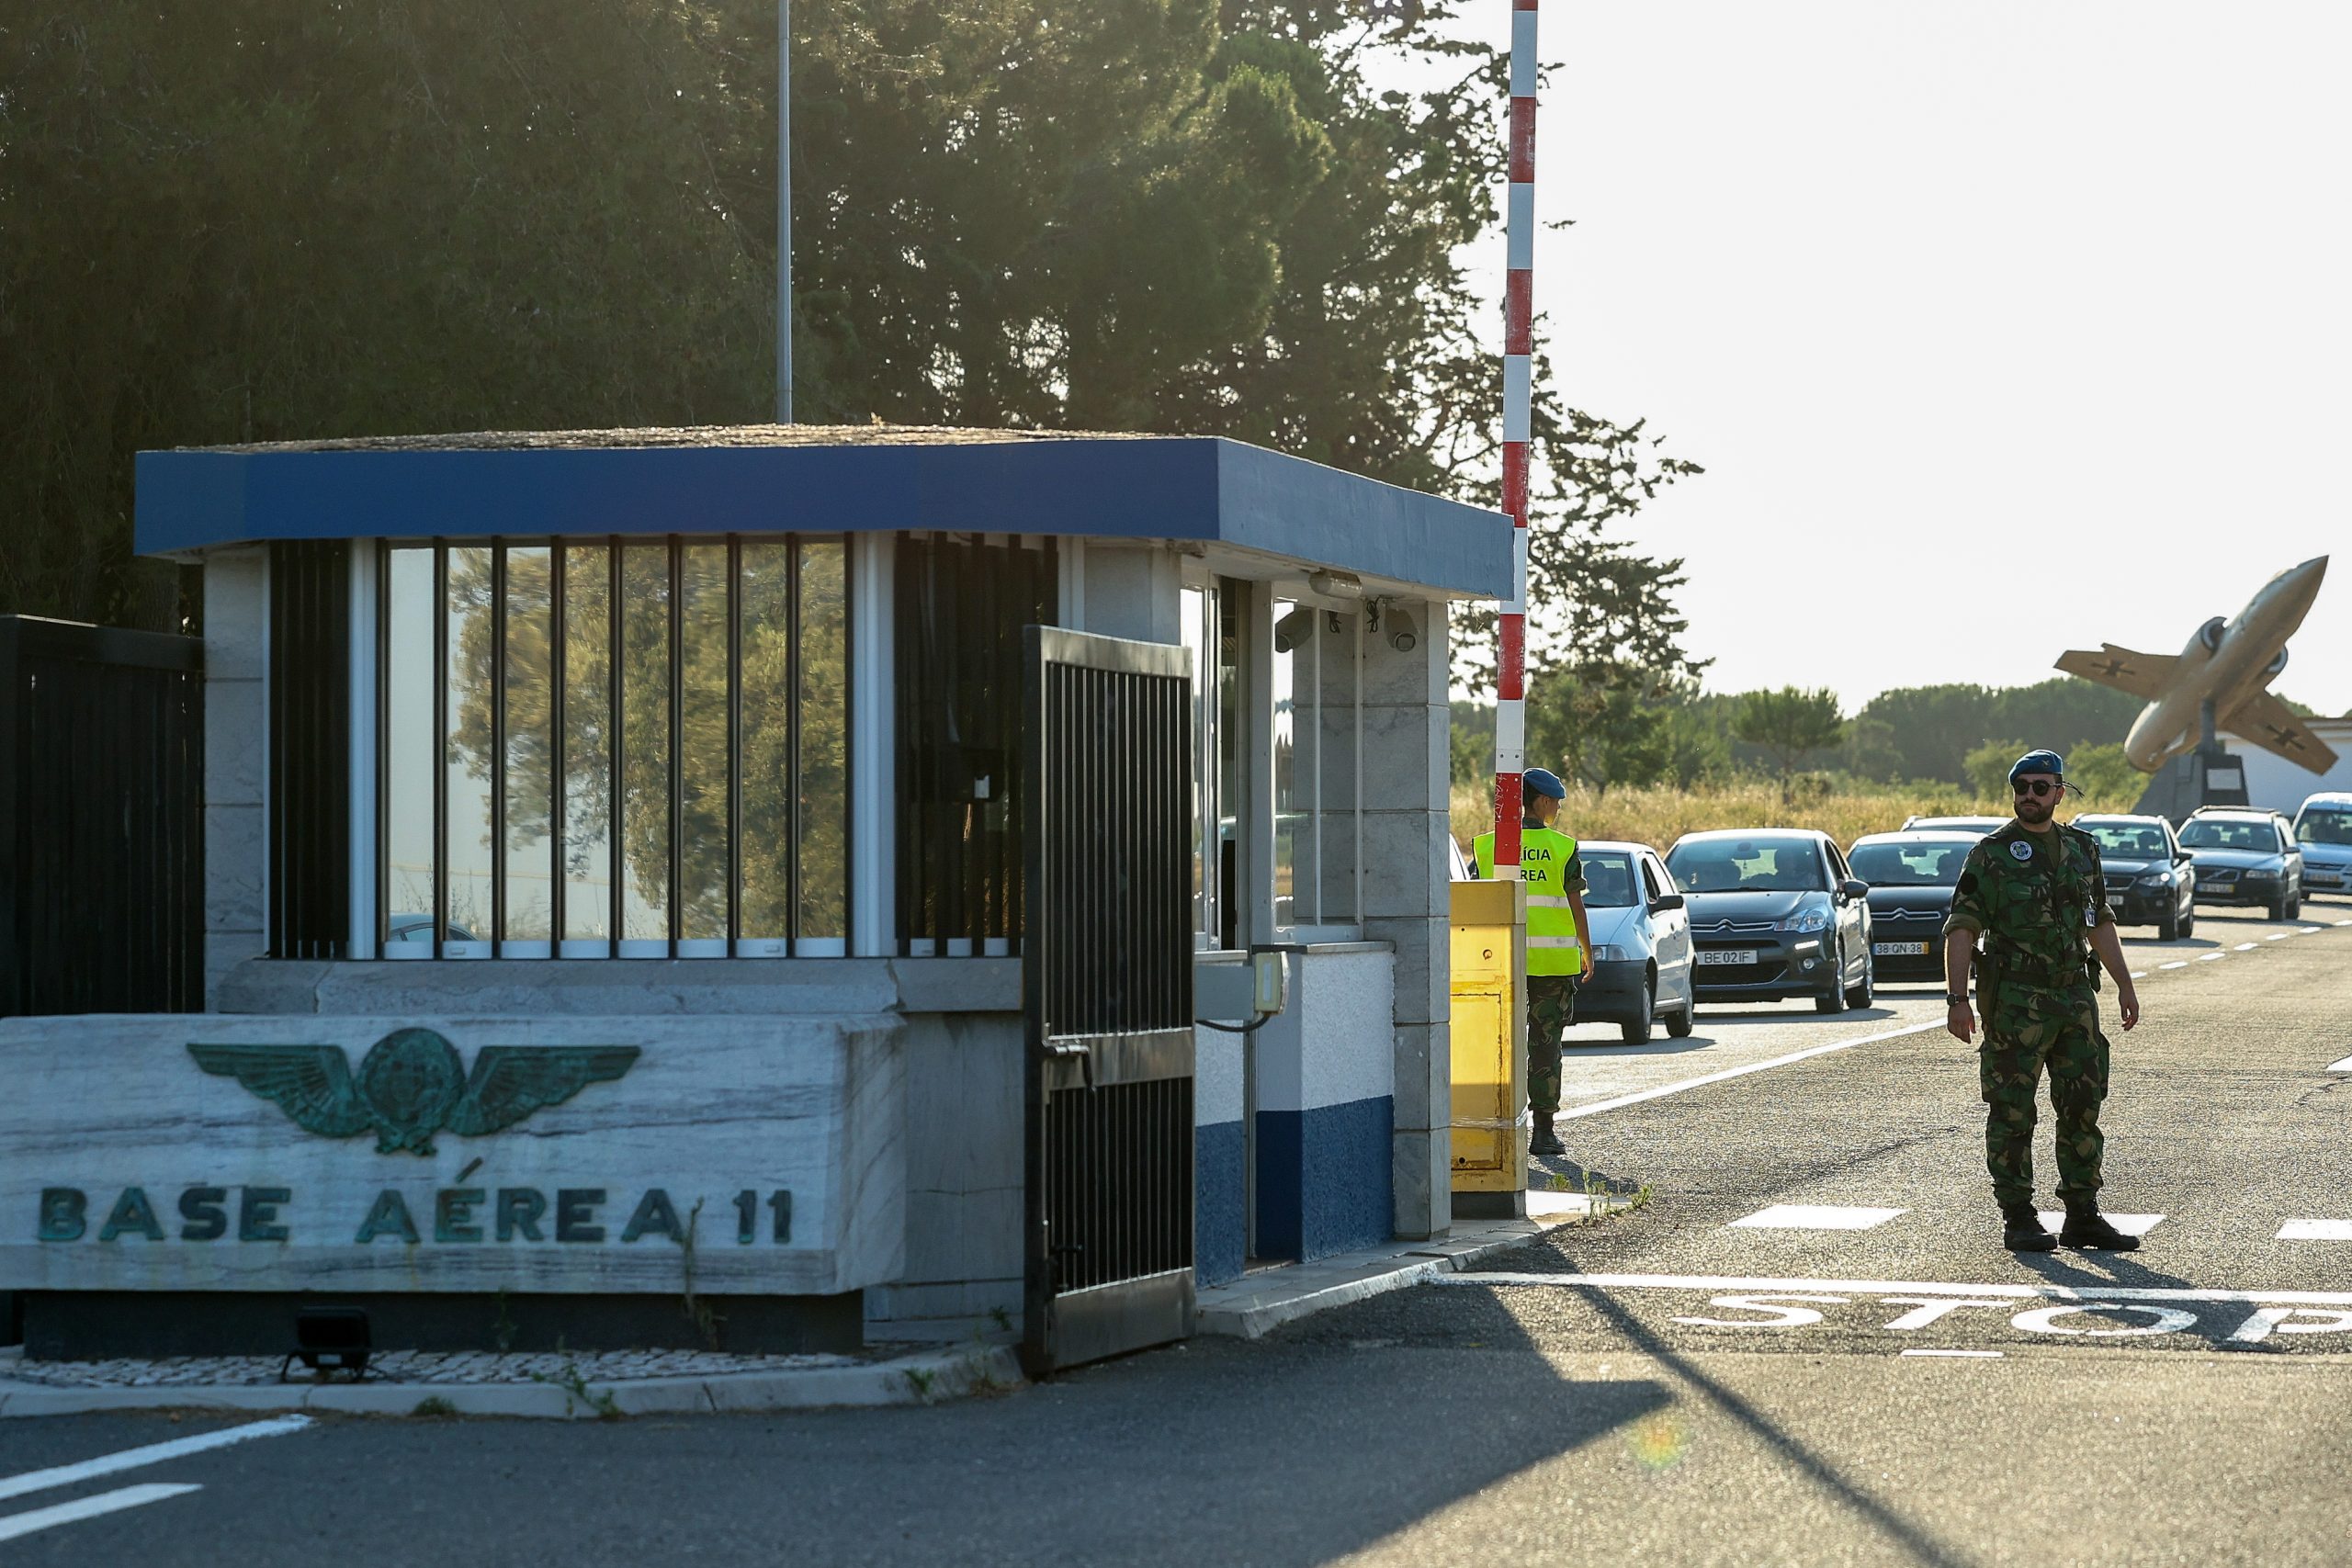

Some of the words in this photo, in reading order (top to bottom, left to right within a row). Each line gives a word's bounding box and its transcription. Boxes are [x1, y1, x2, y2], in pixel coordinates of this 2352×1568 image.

[1521, 846, 1551, 861] ÍCIA
[1521, 869, 1547, 882] REA
[38, 1185, 291, 1242] BASE
[355, 1156, 684, 1244] AÉREA
[733, 1189, 793, 1244] 11
[1669, 1293, 2352, 1342] STOP
